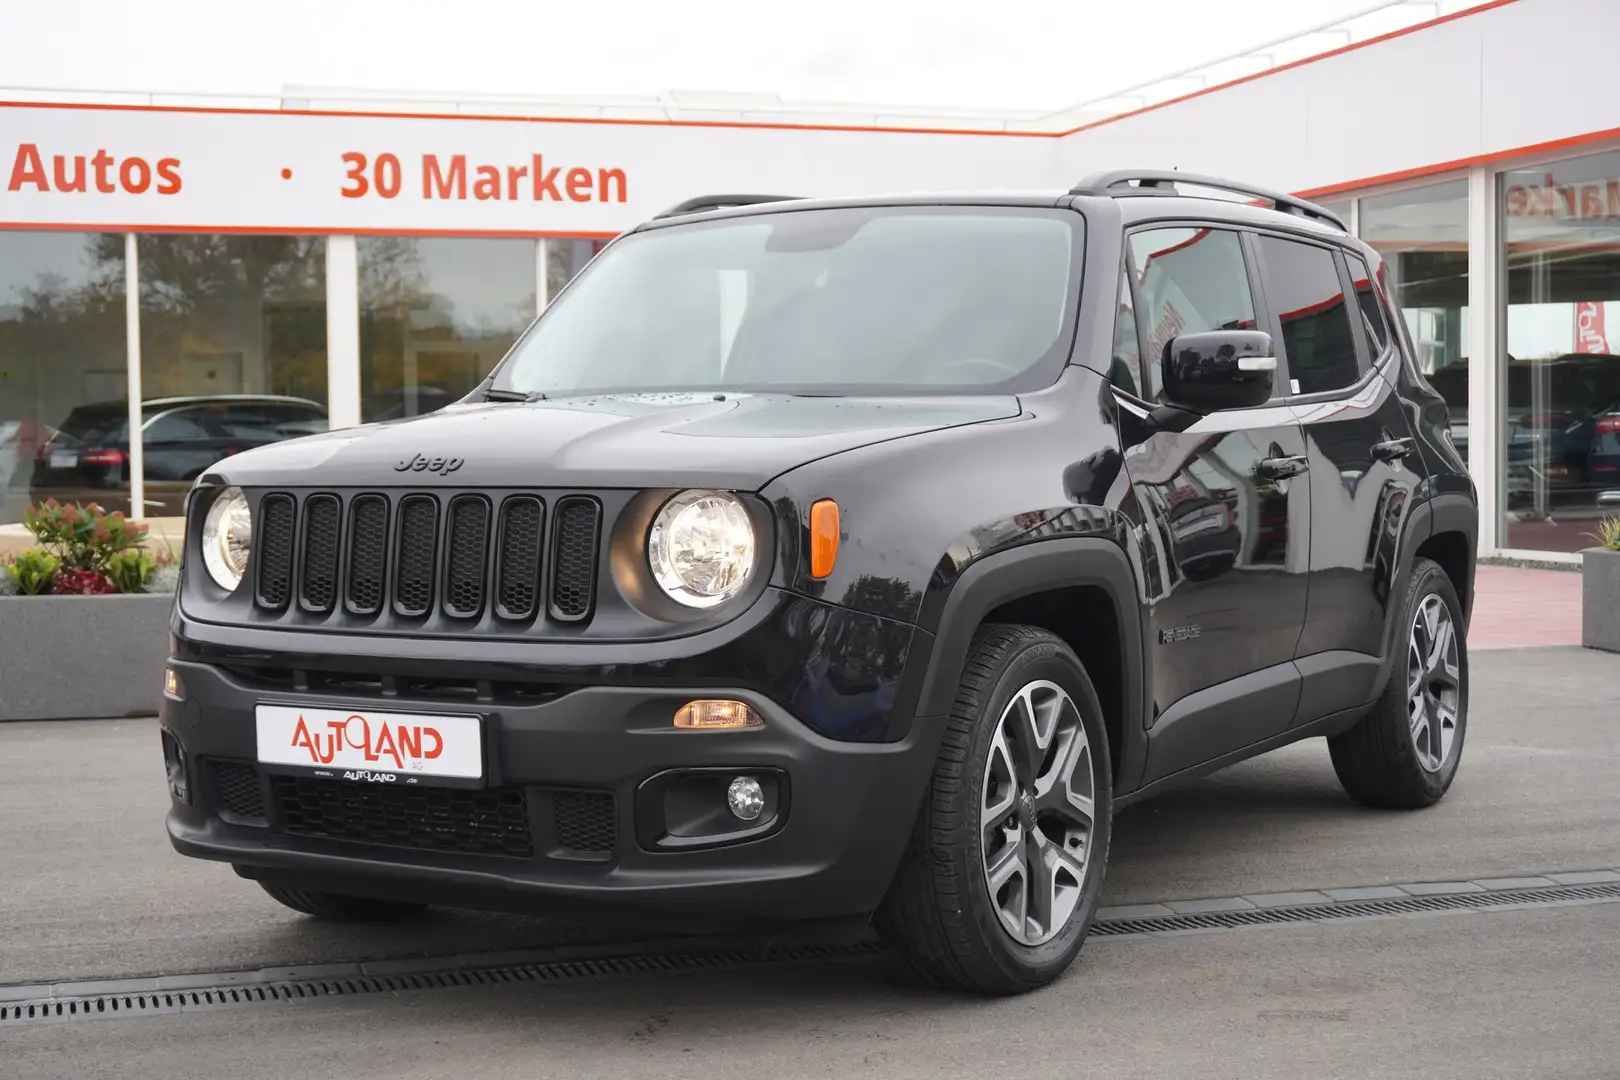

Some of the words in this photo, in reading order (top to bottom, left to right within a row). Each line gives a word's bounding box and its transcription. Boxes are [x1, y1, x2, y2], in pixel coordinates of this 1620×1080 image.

[8, 143, 183, 195] Autos
[340, 151, 402, 199] 30
[421, 153, 628, 203] Marken
[394, 452, 465, 477] Jeep
